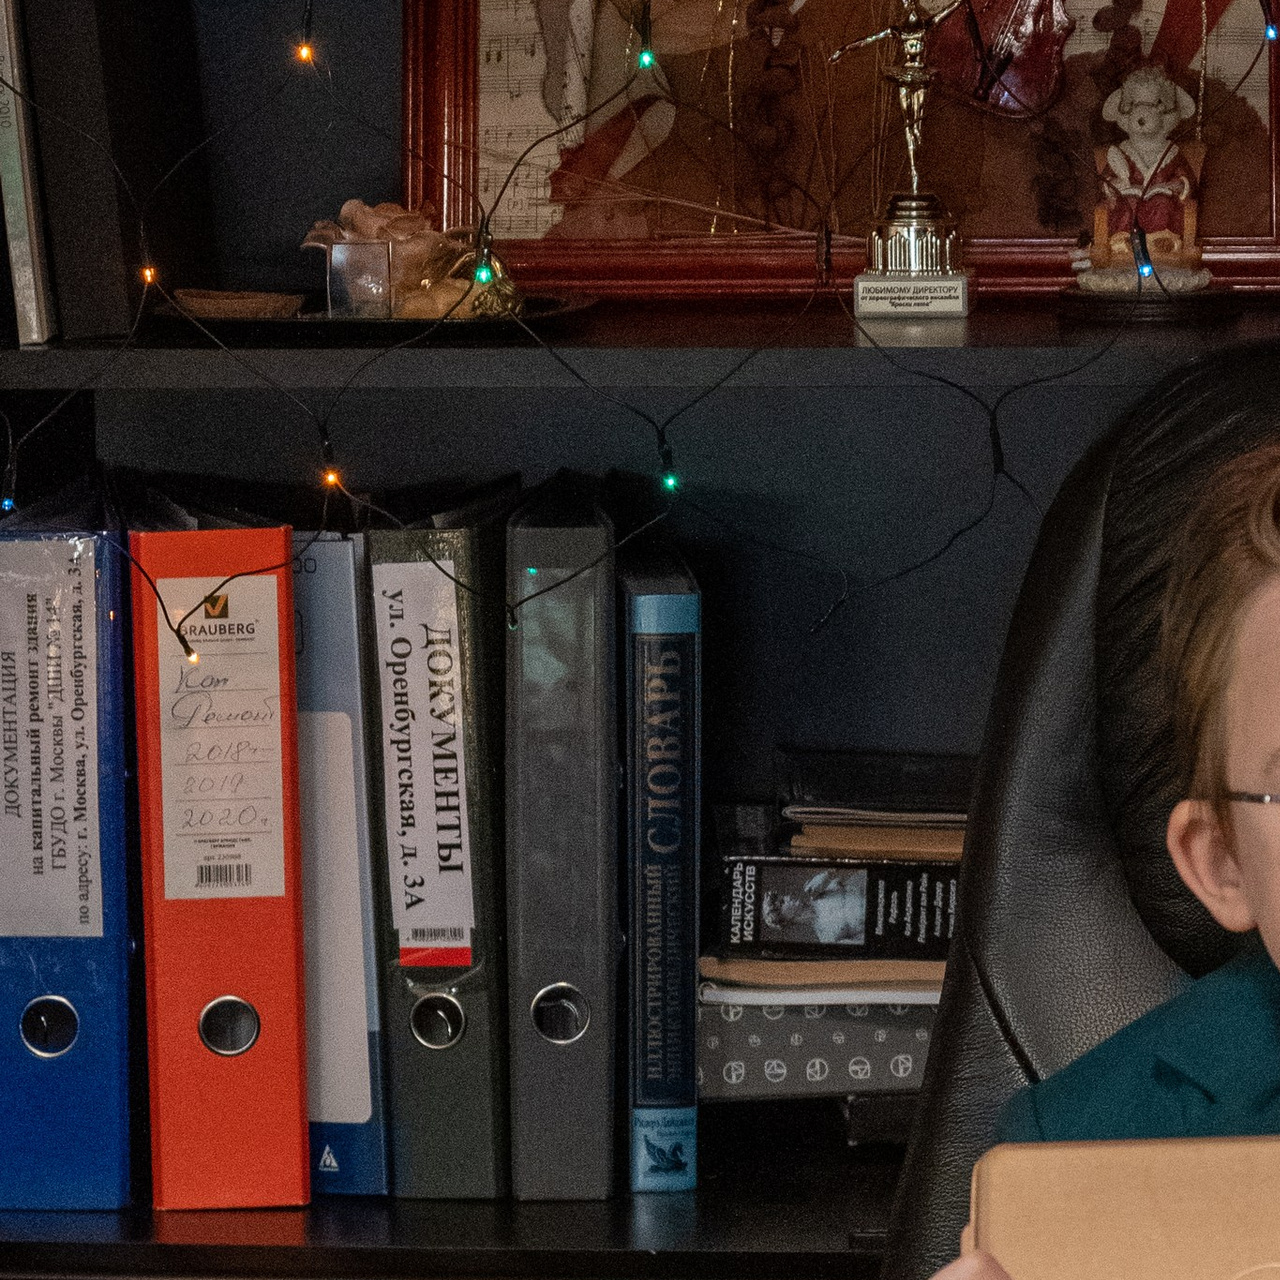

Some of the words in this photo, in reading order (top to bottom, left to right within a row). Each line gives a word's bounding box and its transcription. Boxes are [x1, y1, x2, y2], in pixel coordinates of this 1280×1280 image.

[862, 286, 911, 294] ЛЮБИМОМУ
[912, 286, 958, 295] ДИРЕКТОРУ
[23, 592, 41, 654] здания
[382, 590, 404, 628] ул.
[24, 660, 44, 722] ремонт
[67, 598, 88, 721] Оренбургская,
[1, 651, 21, 817] ДОКУМЕНТАЦИЯ
[47, 714, 67, 783] Москвы
[72, 725, 90, 749] ул.
[386, 637, 416, 837] Оренбургская,
[420, 623, 464, 875] ДОКУМЕНТЫ
[642, 650, 683, 853] СЛОВАРЬ
[22, 727, 46, 850] капитальный
[69, 752, 90, 821] Москва,
[32, 855, 44, 875] на
[48, 805, 69, 869] ГБУДО
[400, 845, 418, 866] д.
[75, 843, 94, 901] адресу:
[730, 862, 743, 943] КАЛЕНДАРЬ
[743, 865, 755, 941] ИСКУССТВ
[76, 905, 90, 924] по
[643, 864, 664, 1078] ИЛЛЮСТРИРОВАННЫЙ
